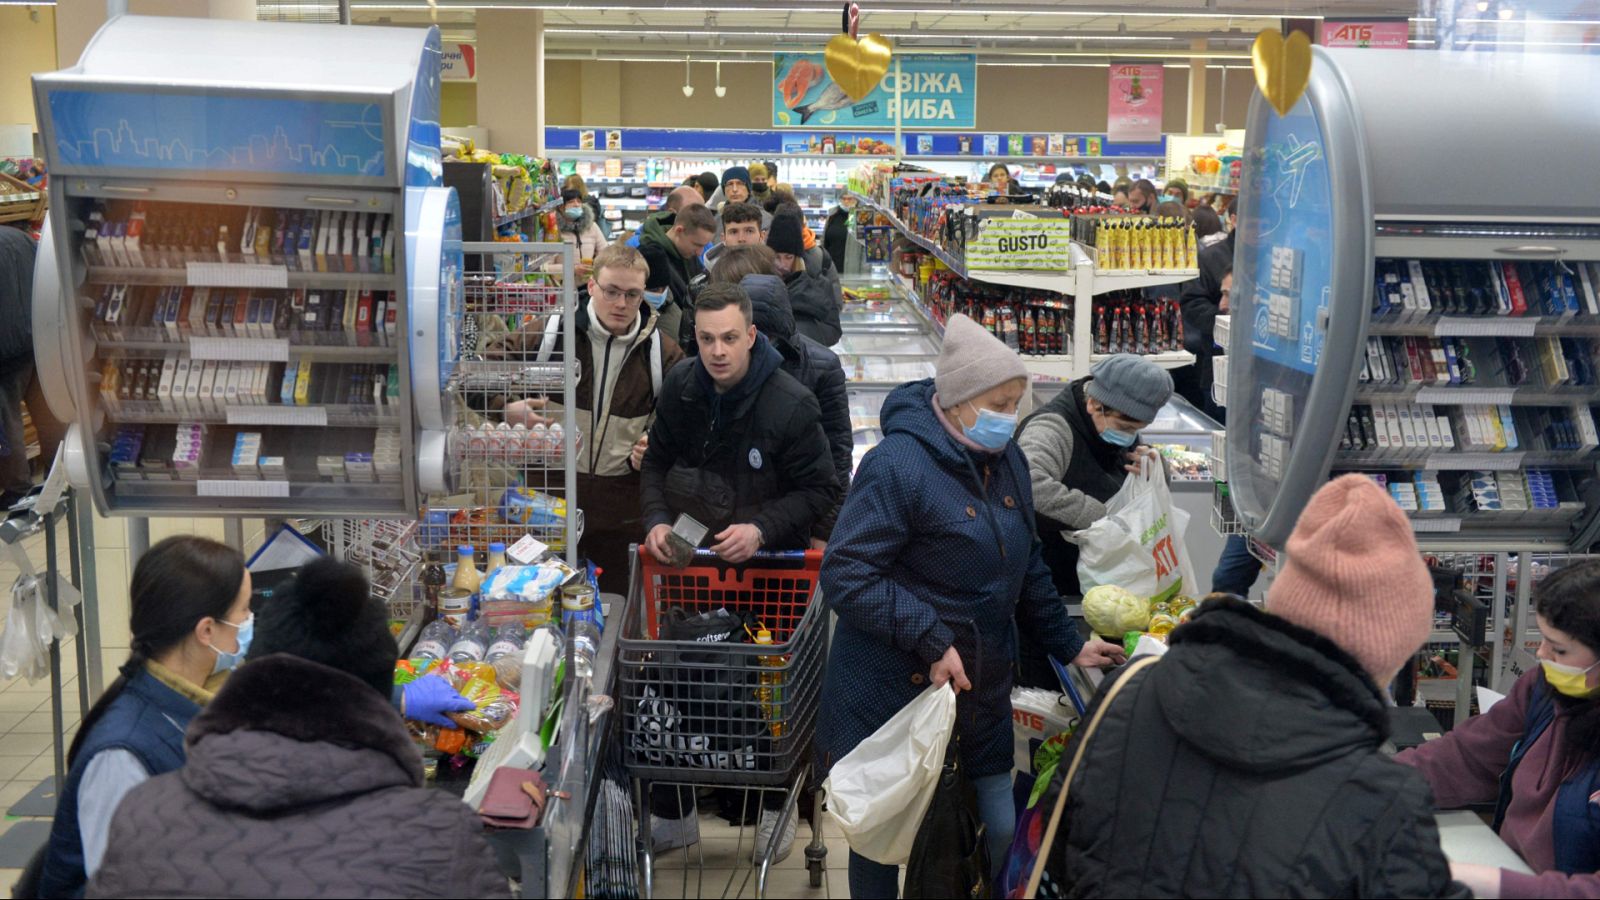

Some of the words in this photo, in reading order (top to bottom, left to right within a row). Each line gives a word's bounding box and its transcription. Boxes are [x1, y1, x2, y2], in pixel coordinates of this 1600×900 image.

[1335, 24, 1375, 40] АТБ
[880, 72, 963, 94] СВІЖА
[998, 230, 1048, 253] GUSTÓ
